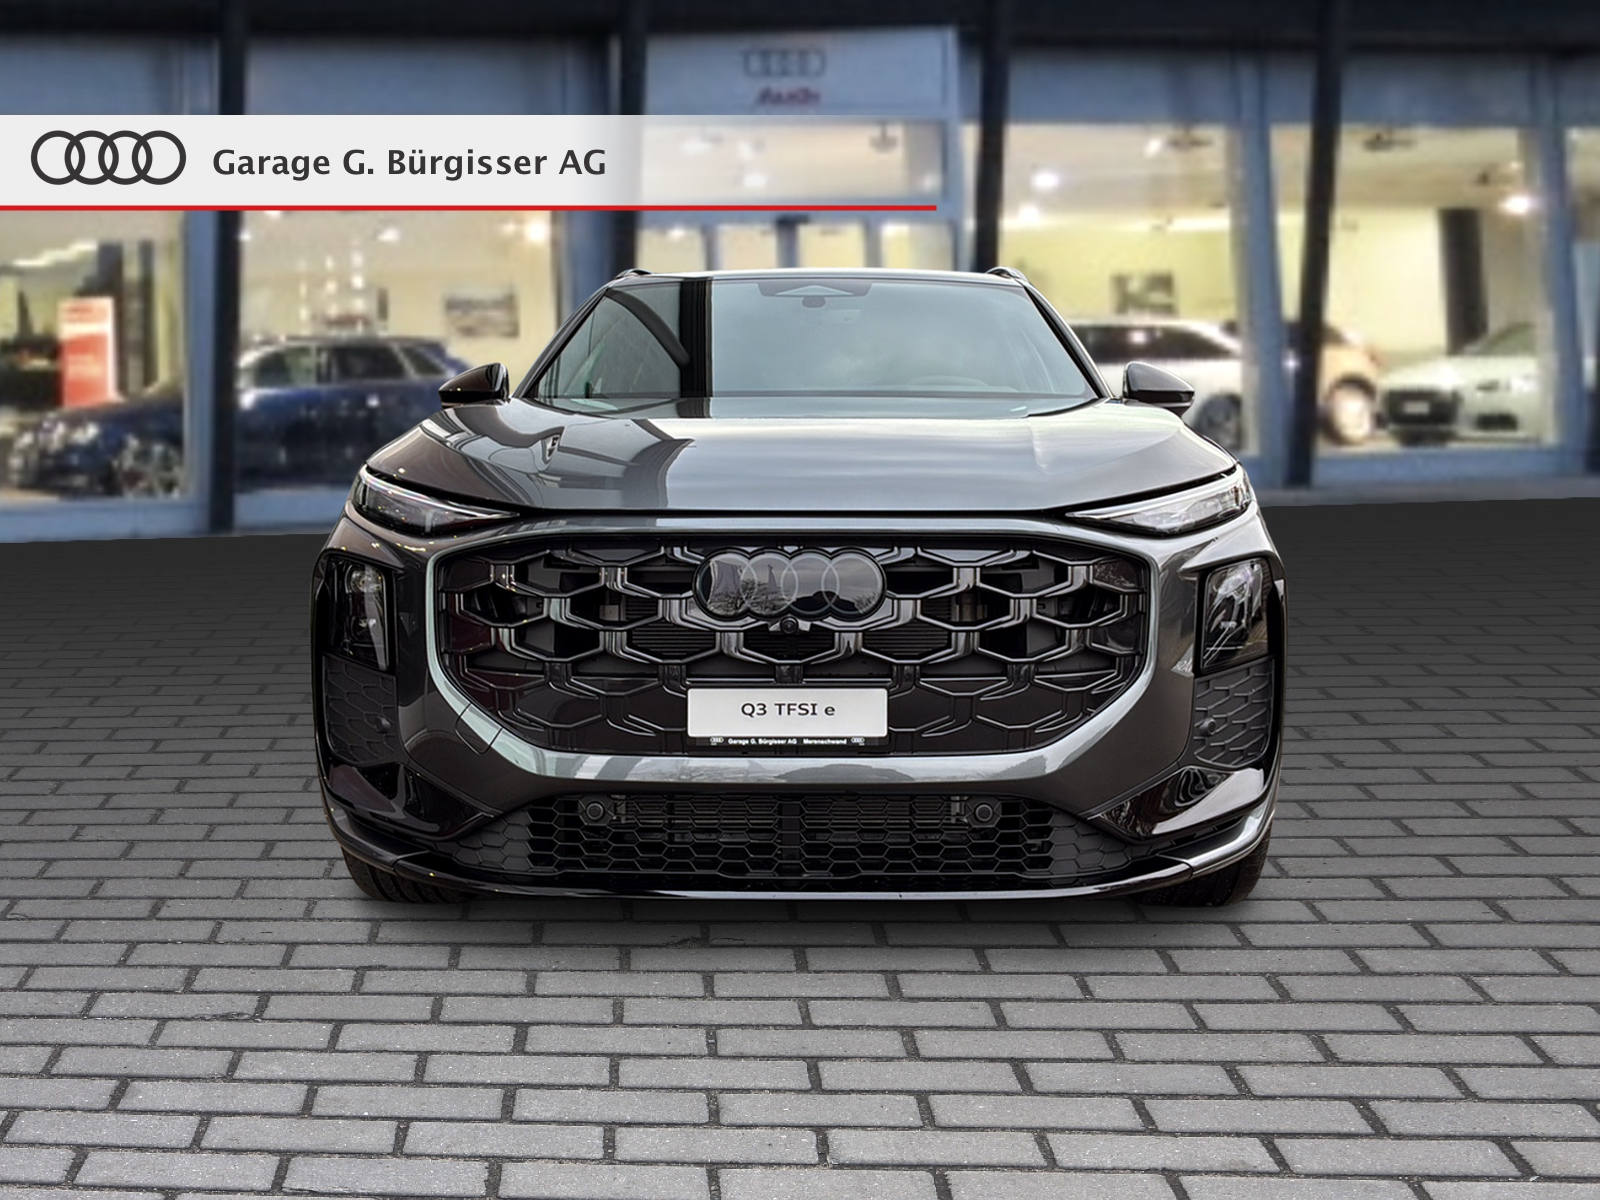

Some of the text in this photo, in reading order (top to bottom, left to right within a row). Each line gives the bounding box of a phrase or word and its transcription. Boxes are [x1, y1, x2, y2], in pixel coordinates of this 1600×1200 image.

[741, 702, 836, 718] Q3 TFSI e
[727, 738, 749, 746] Garage
